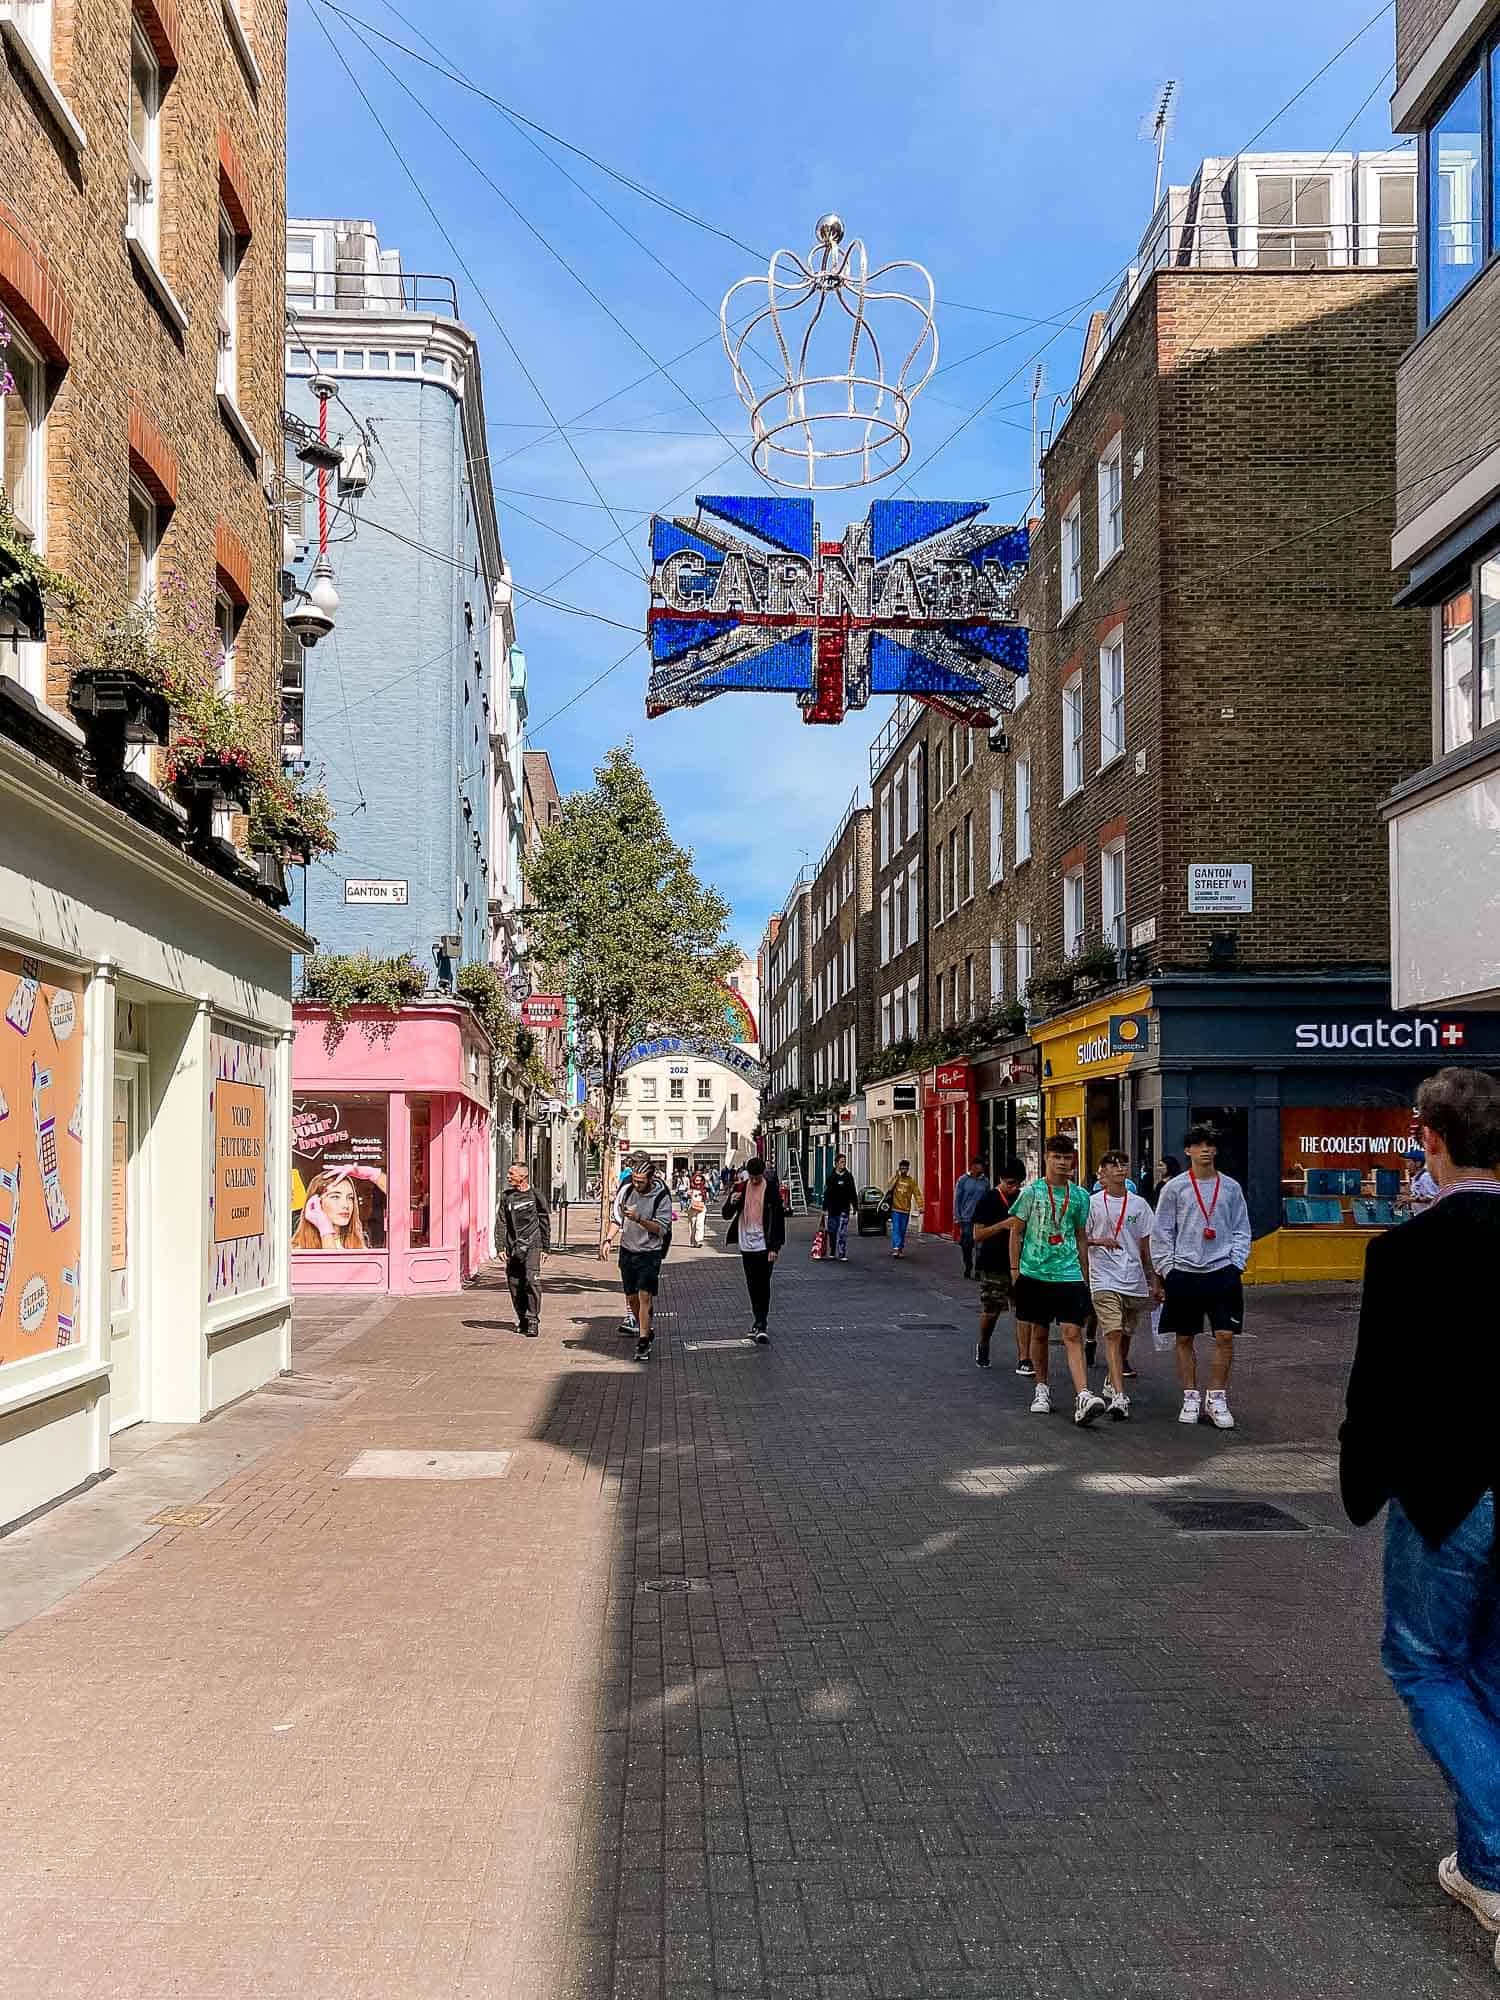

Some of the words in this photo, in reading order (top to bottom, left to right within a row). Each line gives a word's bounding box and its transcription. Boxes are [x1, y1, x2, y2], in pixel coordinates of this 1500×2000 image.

[659, 549, 1028, 623] CARNABY
[1195, 868, 1232, 878] GANTON
[347, 886, 387, 896] GANTON
[1195, 879, 1230, 888] STREET
[1232, 879, 1247, 888] W1
[527, 1003, 555, 1015] MUJI
[1296, 1018, 1438, 1048] swatch
[231, 1105, 251, 1127] YOUR
[221, 1136, 251, 1157] FUTURE
[253, 1137, 261, 1156] IS
[298, 1130, 349, 1150] brows
[1299, 1136, 1320, 1153] THE
[1320, 1136, 1369, 1153] COOLEST
[1369, 1136, 1391, 1153] WAY
[1391, 1136, 1406, 1153] TO
[225, 1168, 256, 1188] CALLING
